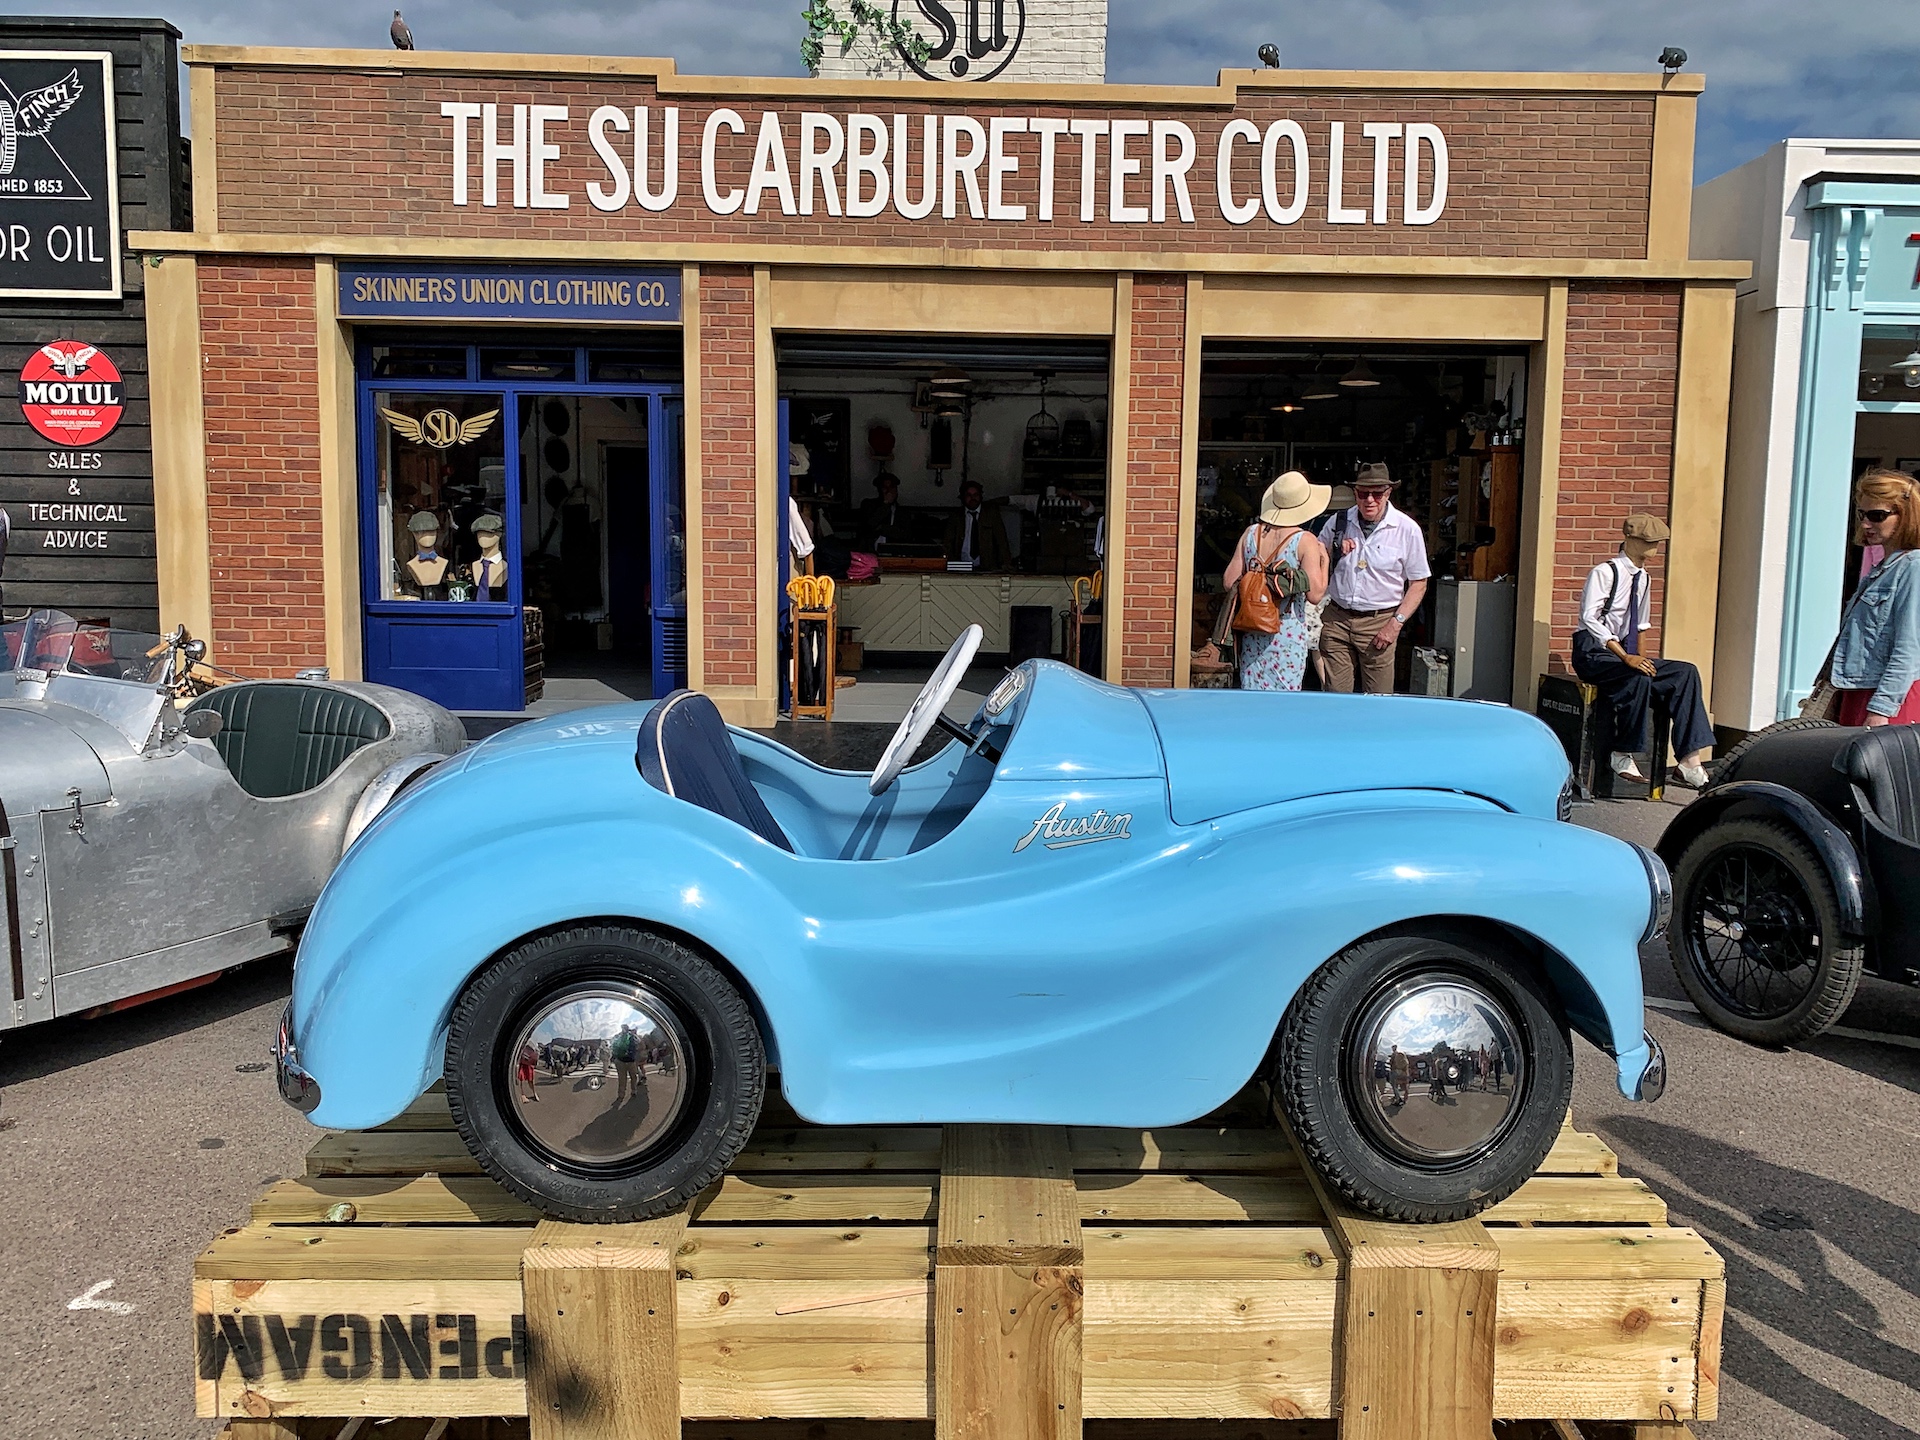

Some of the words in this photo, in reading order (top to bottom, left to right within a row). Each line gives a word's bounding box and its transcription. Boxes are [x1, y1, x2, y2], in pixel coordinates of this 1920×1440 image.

[19, 83, 69, 128] FINCH
[440, 101, 570, 209] THE
[585, 104, 679, 212] SU
[700, 107, 1197, 223] CARBURETTER
[1216, 118, 1310, 225] CO
[1327, 121, 1449, 226] LTD
[0, 179, 28, 192] HED
[34, 179, 63, 193] 1853
[47, 225, 104, 262] OIL
[353, 276, 457, 303] SKINNERS
[461, 278, 525, 304] UNION
[529, 280, 631, 306] CLOTHING
[636, 281, 670, 308] CO.
[25, 382, 119, 405] MOTUL
[48, 452, 102, 470] SALES
[68, 478, 81, 496] &
[28, 503, 127, 522] TECHNICAL
[43, 530, 108, 549] ADVICE
[1013, 800, 1133, 853] Austin
[195, 1314, 526, 1380] PENGAM
